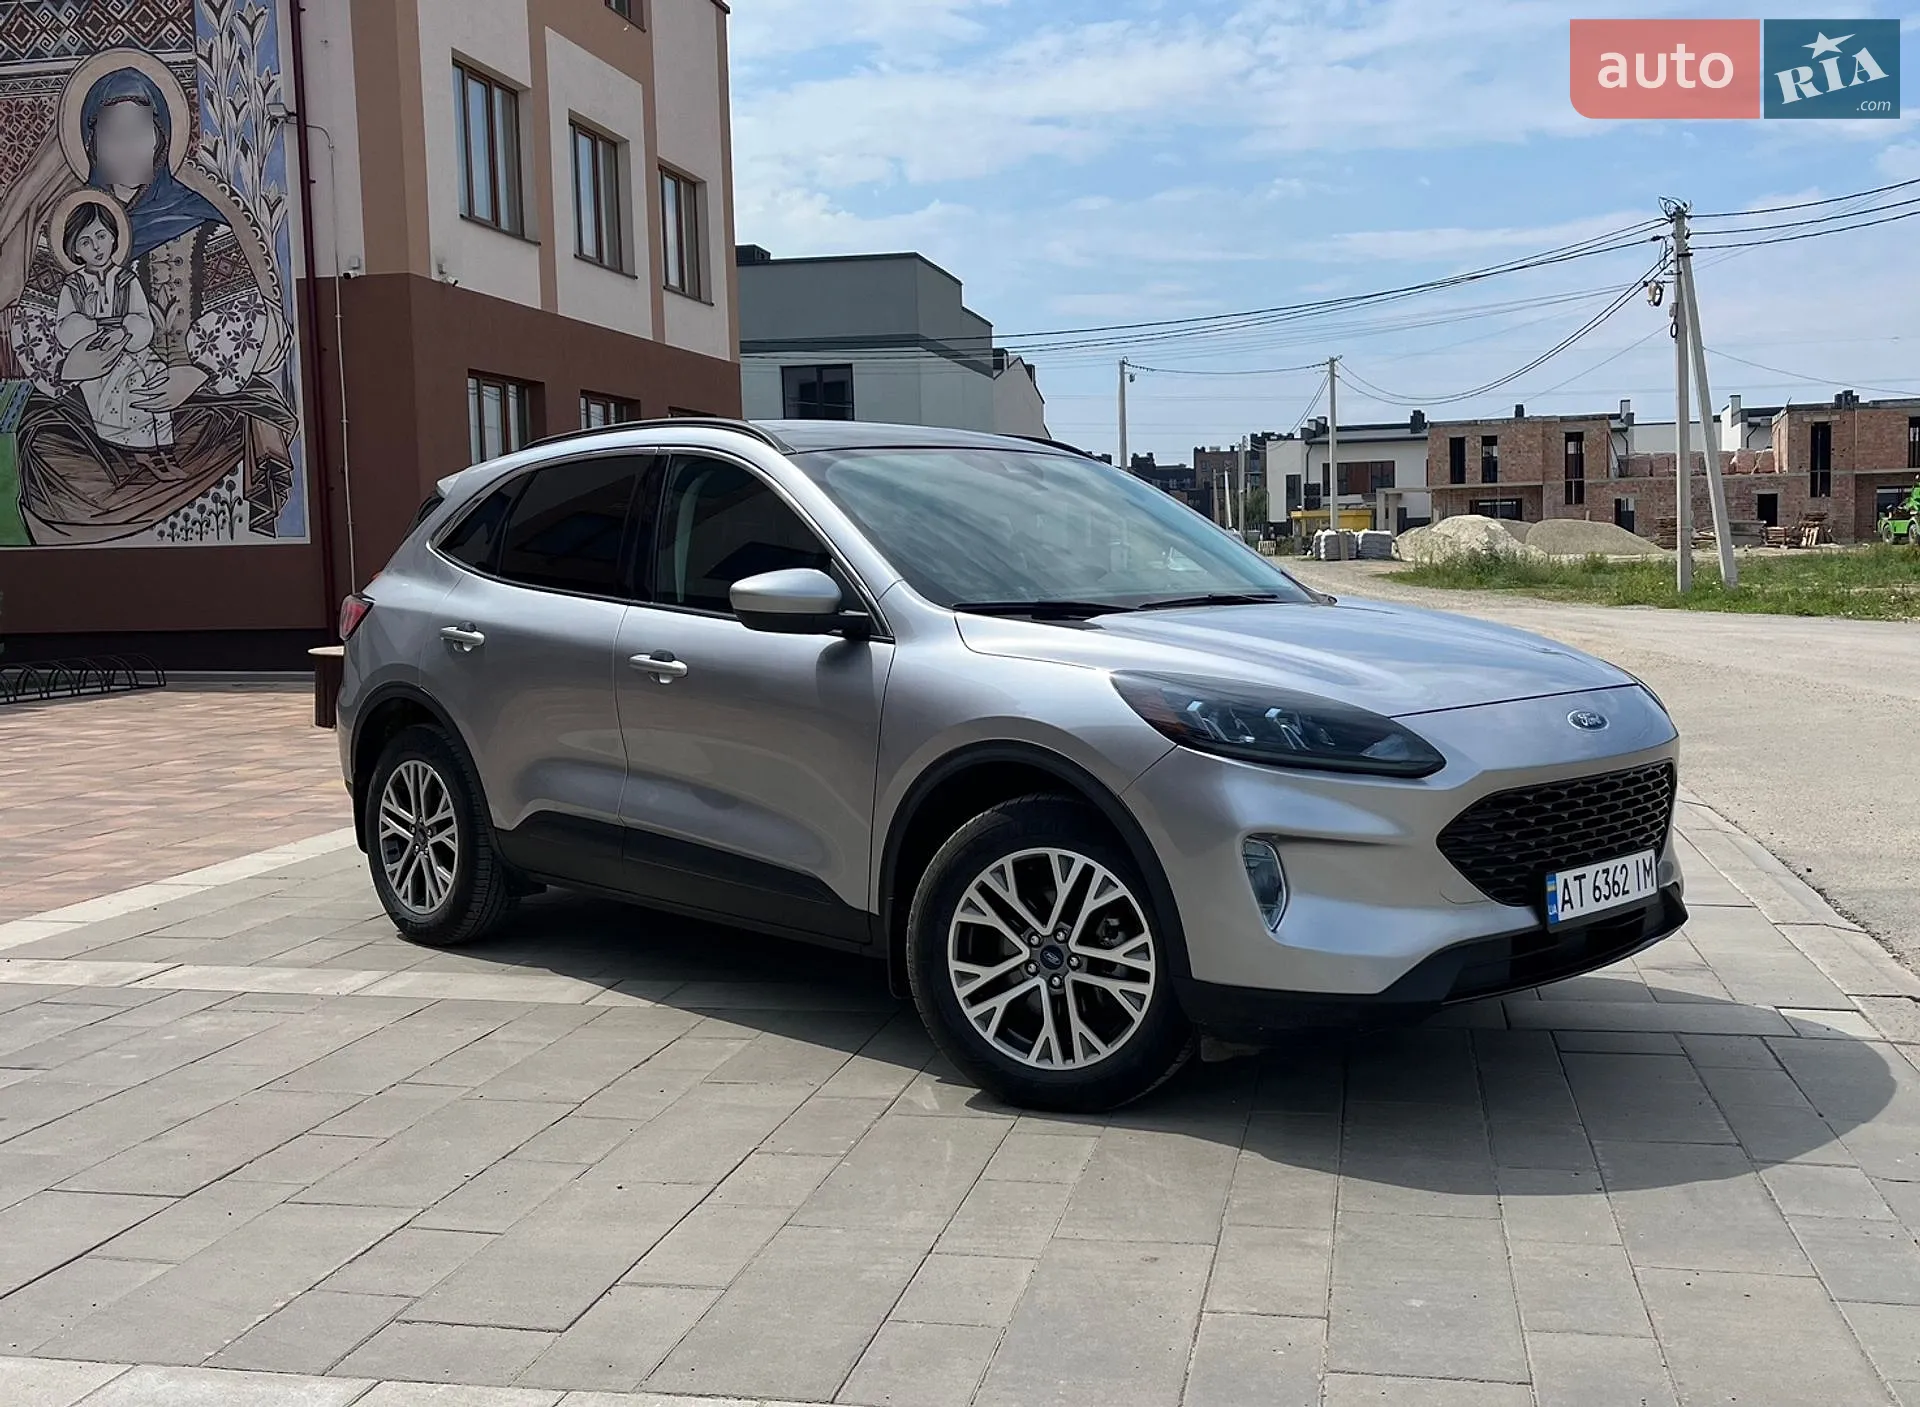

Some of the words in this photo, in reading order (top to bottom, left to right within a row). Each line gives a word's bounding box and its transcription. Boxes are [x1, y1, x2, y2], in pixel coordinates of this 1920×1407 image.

[1560, 873, 1587, 912] AT
[1592, 863, 1630, 903] 6362
[1635, 855, 1655, 891] IM
